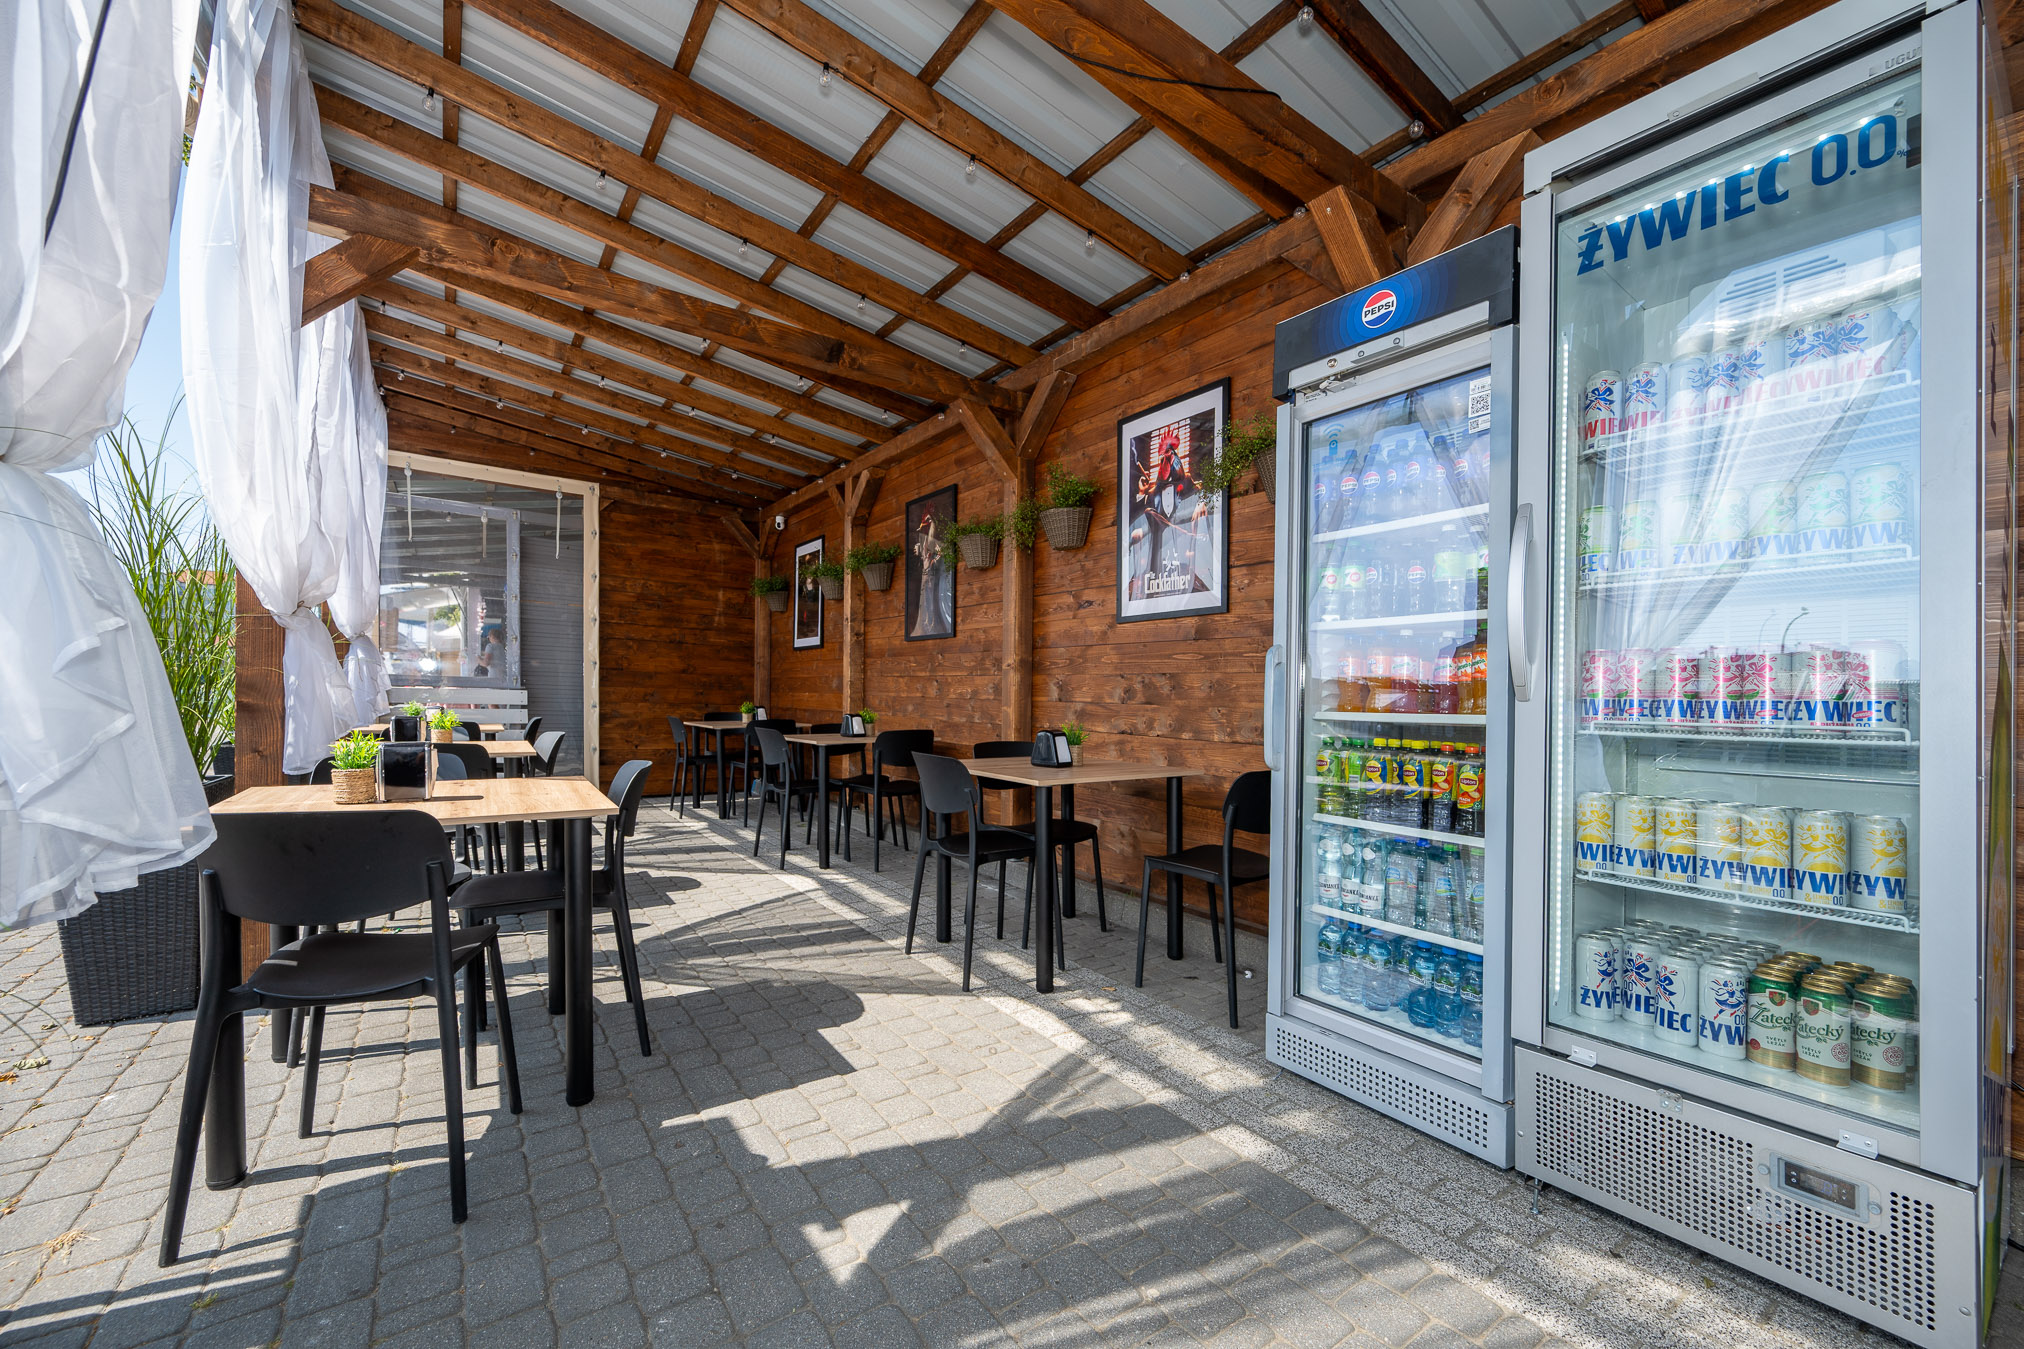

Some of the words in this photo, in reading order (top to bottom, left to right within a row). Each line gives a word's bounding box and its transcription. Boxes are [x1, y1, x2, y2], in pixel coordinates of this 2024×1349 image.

[1577, 153, 1789, 276] ŻYWIEC
[1364, 300, 1395, 318] PEPSI
[1144, 571, 1191, 594] Cockfather
[1460, 777, 1477, 786] Lipton
[1797, 1018, 1844, 1041] atecký
